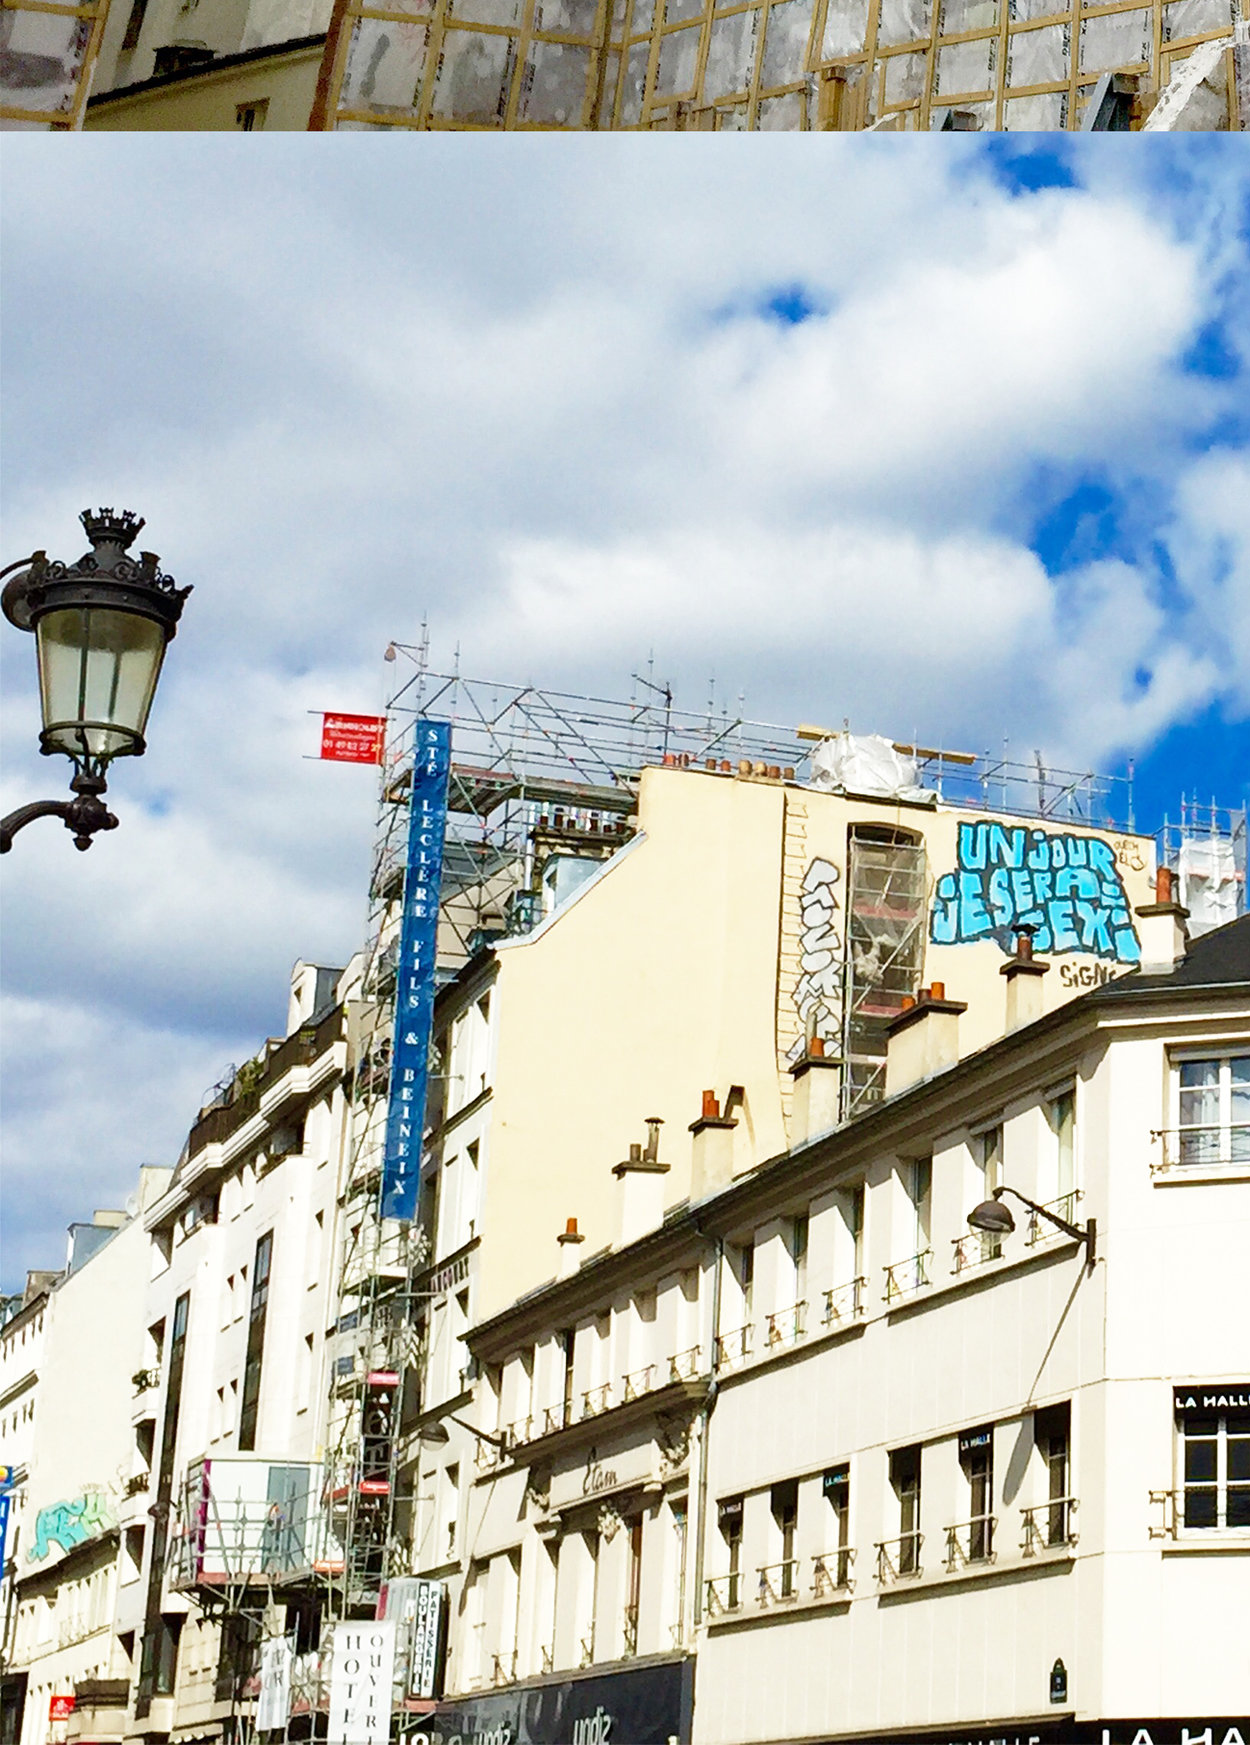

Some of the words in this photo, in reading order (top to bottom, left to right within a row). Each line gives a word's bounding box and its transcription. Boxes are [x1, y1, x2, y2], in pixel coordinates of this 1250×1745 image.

[415, 799, 434, 919] LECLÈRE
[409, 940, 424, 1008] FILS
[405, 1032, 418, 1046] &
[393, 1068, 414, 1194] BEINEIX
[1176, 1397, 1197, 1408] LA
